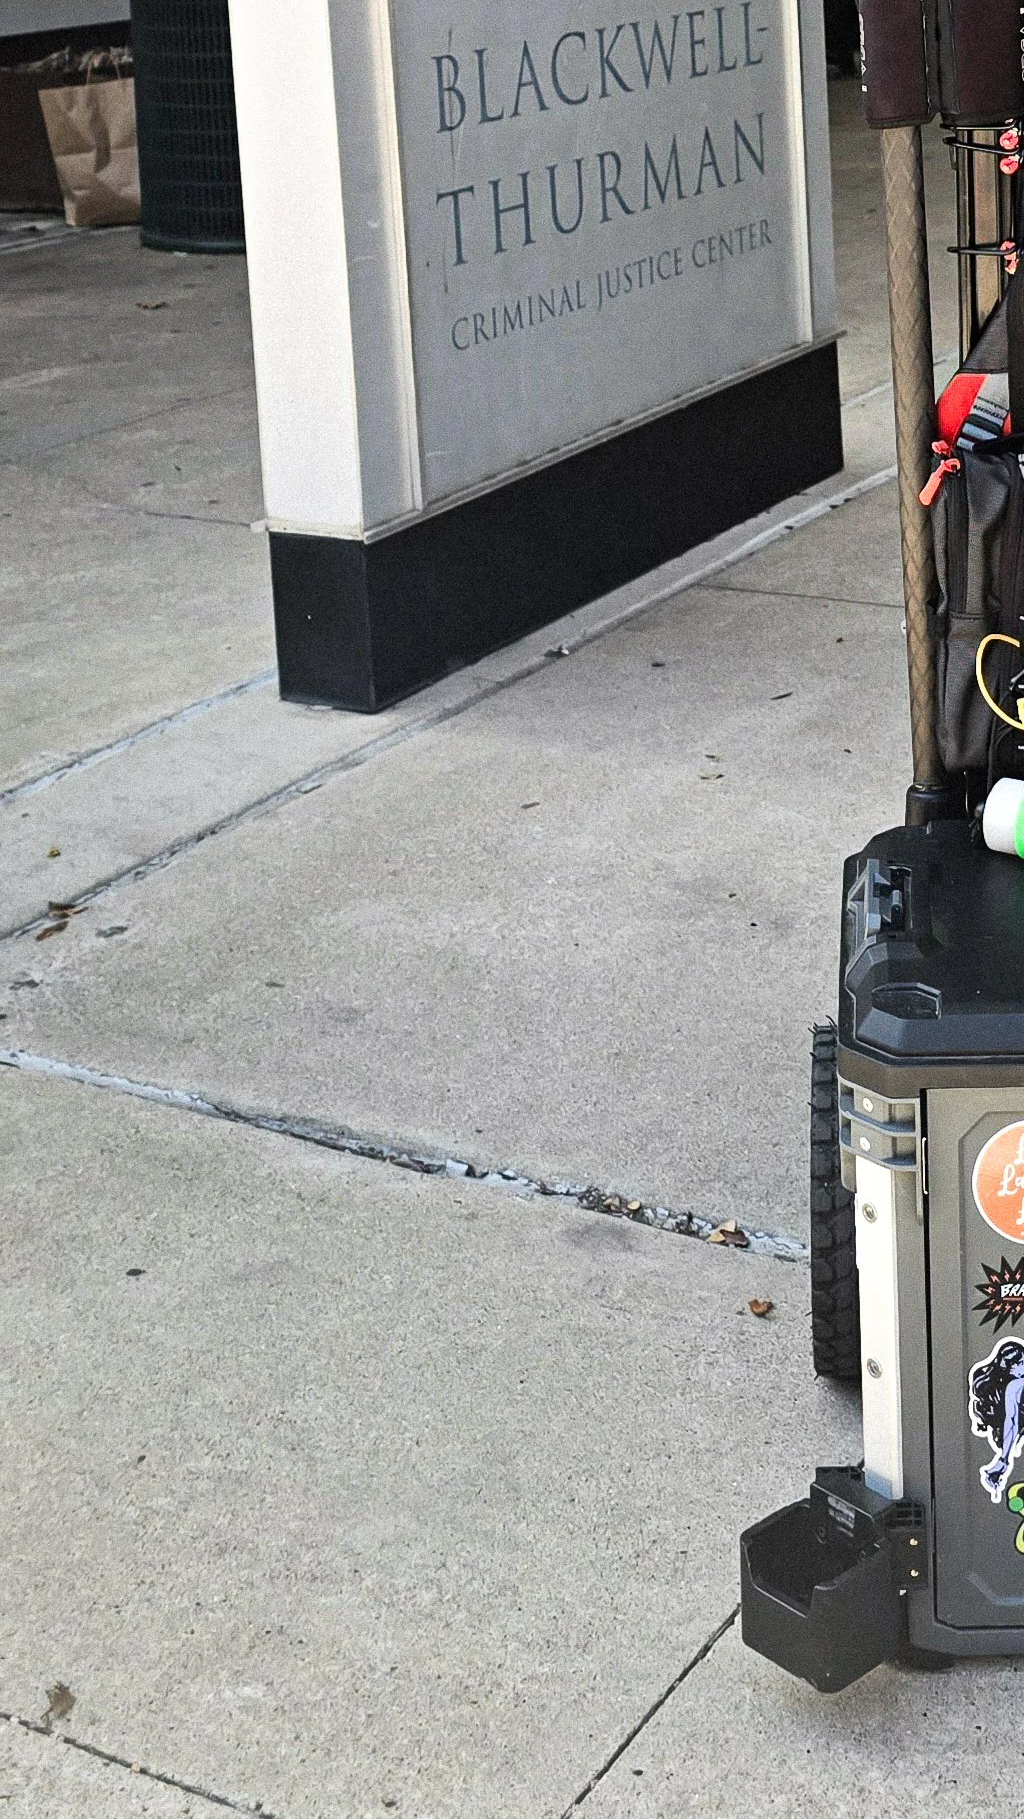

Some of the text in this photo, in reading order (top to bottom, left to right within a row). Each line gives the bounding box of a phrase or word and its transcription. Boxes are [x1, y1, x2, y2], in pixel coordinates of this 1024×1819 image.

[431, 1, 769, 134] BLACKWELL-
[435, 112, 767, 267] THURMAN
[451, 219, 772, 351] CRIMINAL JUSTICE CENTER
